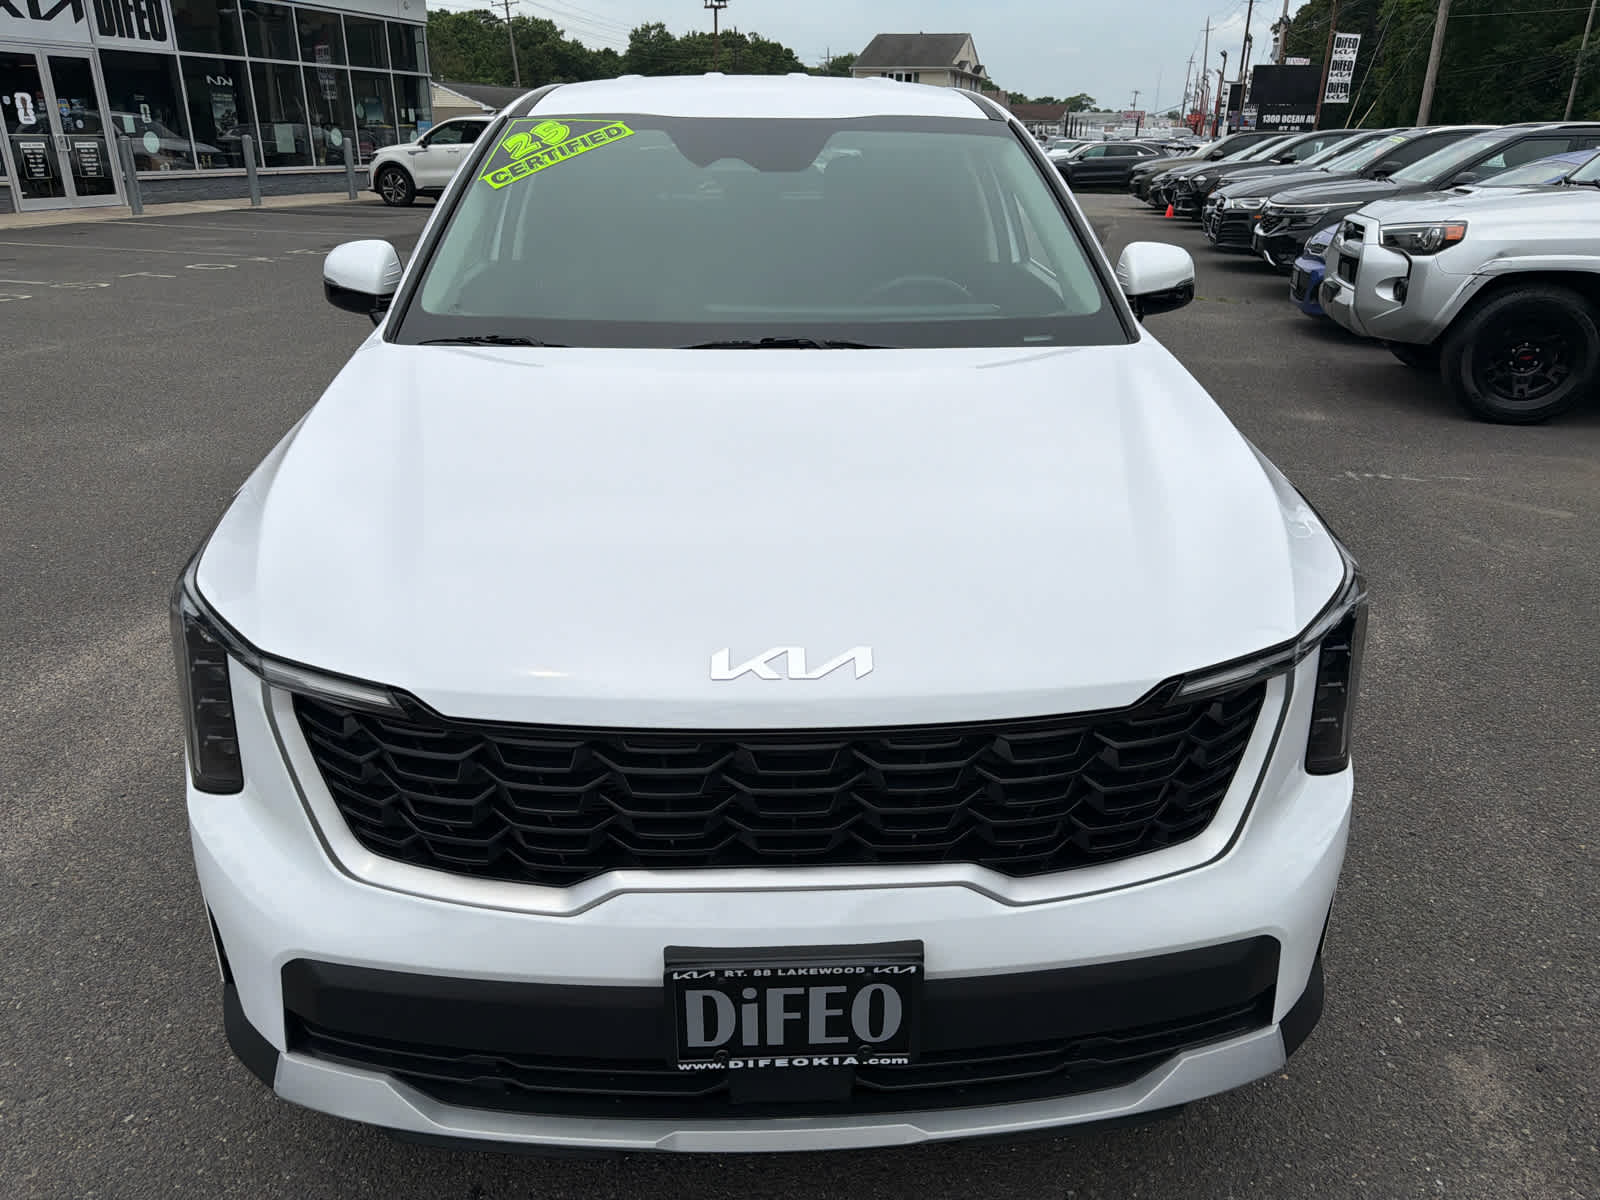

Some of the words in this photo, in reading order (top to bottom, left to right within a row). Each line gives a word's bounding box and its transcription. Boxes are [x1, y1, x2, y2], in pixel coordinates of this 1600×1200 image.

[1262, 114, 1280, 123] 1300
[1281, 114, 1305, 123] OCEAN
[490, 125, 627, 184] CERTIFIED
[711, 647, 873, 680] KIA
[672, 970, 715, 980] KIA
[724, 969, 748, 978] RT.
[753, 968, 771, 977] 88
[777, 966, 865, 977] LAKEWOOD
[873, 965, 917, 975] KIA
[685, 983, 902, 1047] DiFEO
[678, 1056, 908, 1071] www.DIFEOKIA.com
